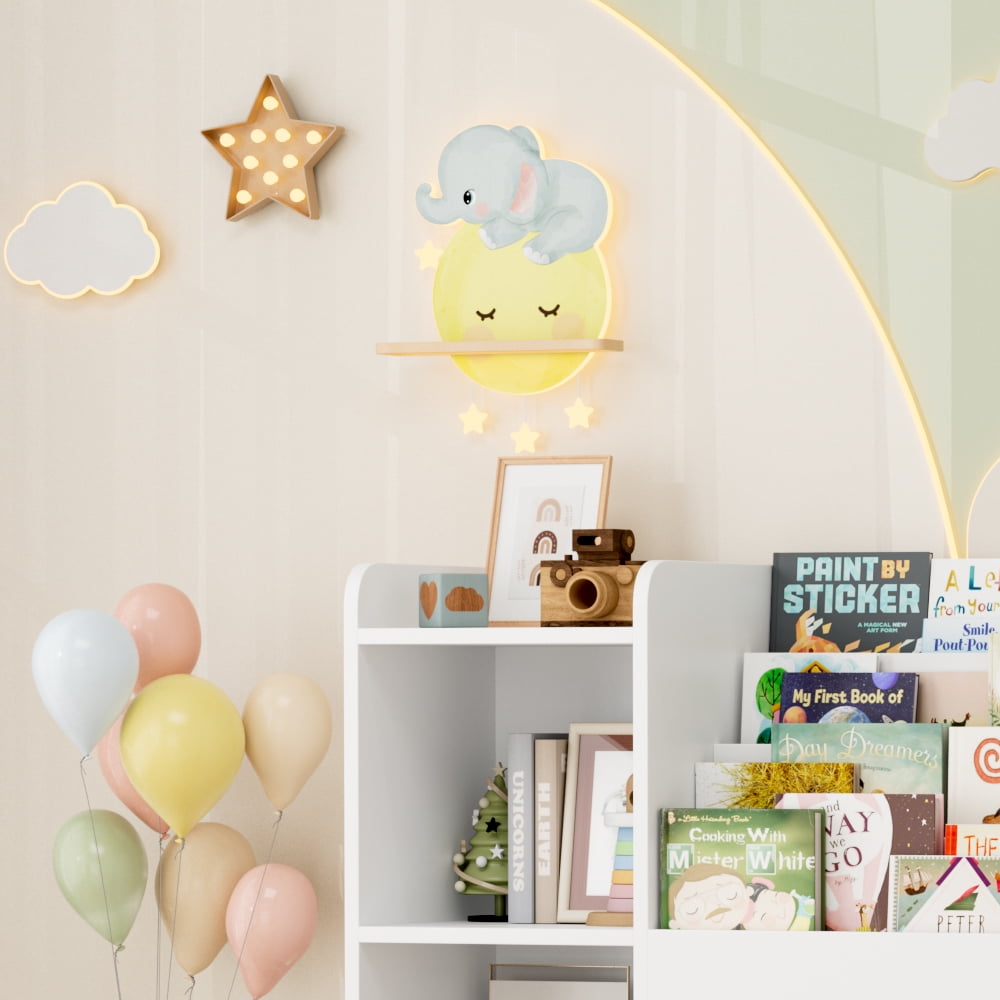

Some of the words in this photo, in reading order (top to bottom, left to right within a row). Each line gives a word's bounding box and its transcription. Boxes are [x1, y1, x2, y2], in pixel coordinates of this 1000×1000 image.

[796, 556, 879, 581] PAINT
[881, 559, 910, 579] BY
[945, 569, 959, 592] A
[783, 583, 920, 614] STICKER
[933, 596, 965, 618] from
[968, 598, 1000, 616] your
[934, 638, 989, 652] Pout-Pou
[792, 689, 811, 708] My
[814, 689, 847, 704] First
[850, 688, 884, 704] Book
[888, 689, 904, 704] of
[778, 733, 828, 763] Day
[836, 726, 939, 769] Dreamers
[821, 800, 840, 812] nd
[512, 771, 525, 893] UNICORNS
[537, 782, 552, 877] EARTH
[689, 827, 746, 845] Cooking
[747, 827, 787, 842] With
[830, 839, 846, 849] we
[824, 846, 863, 873] GO
